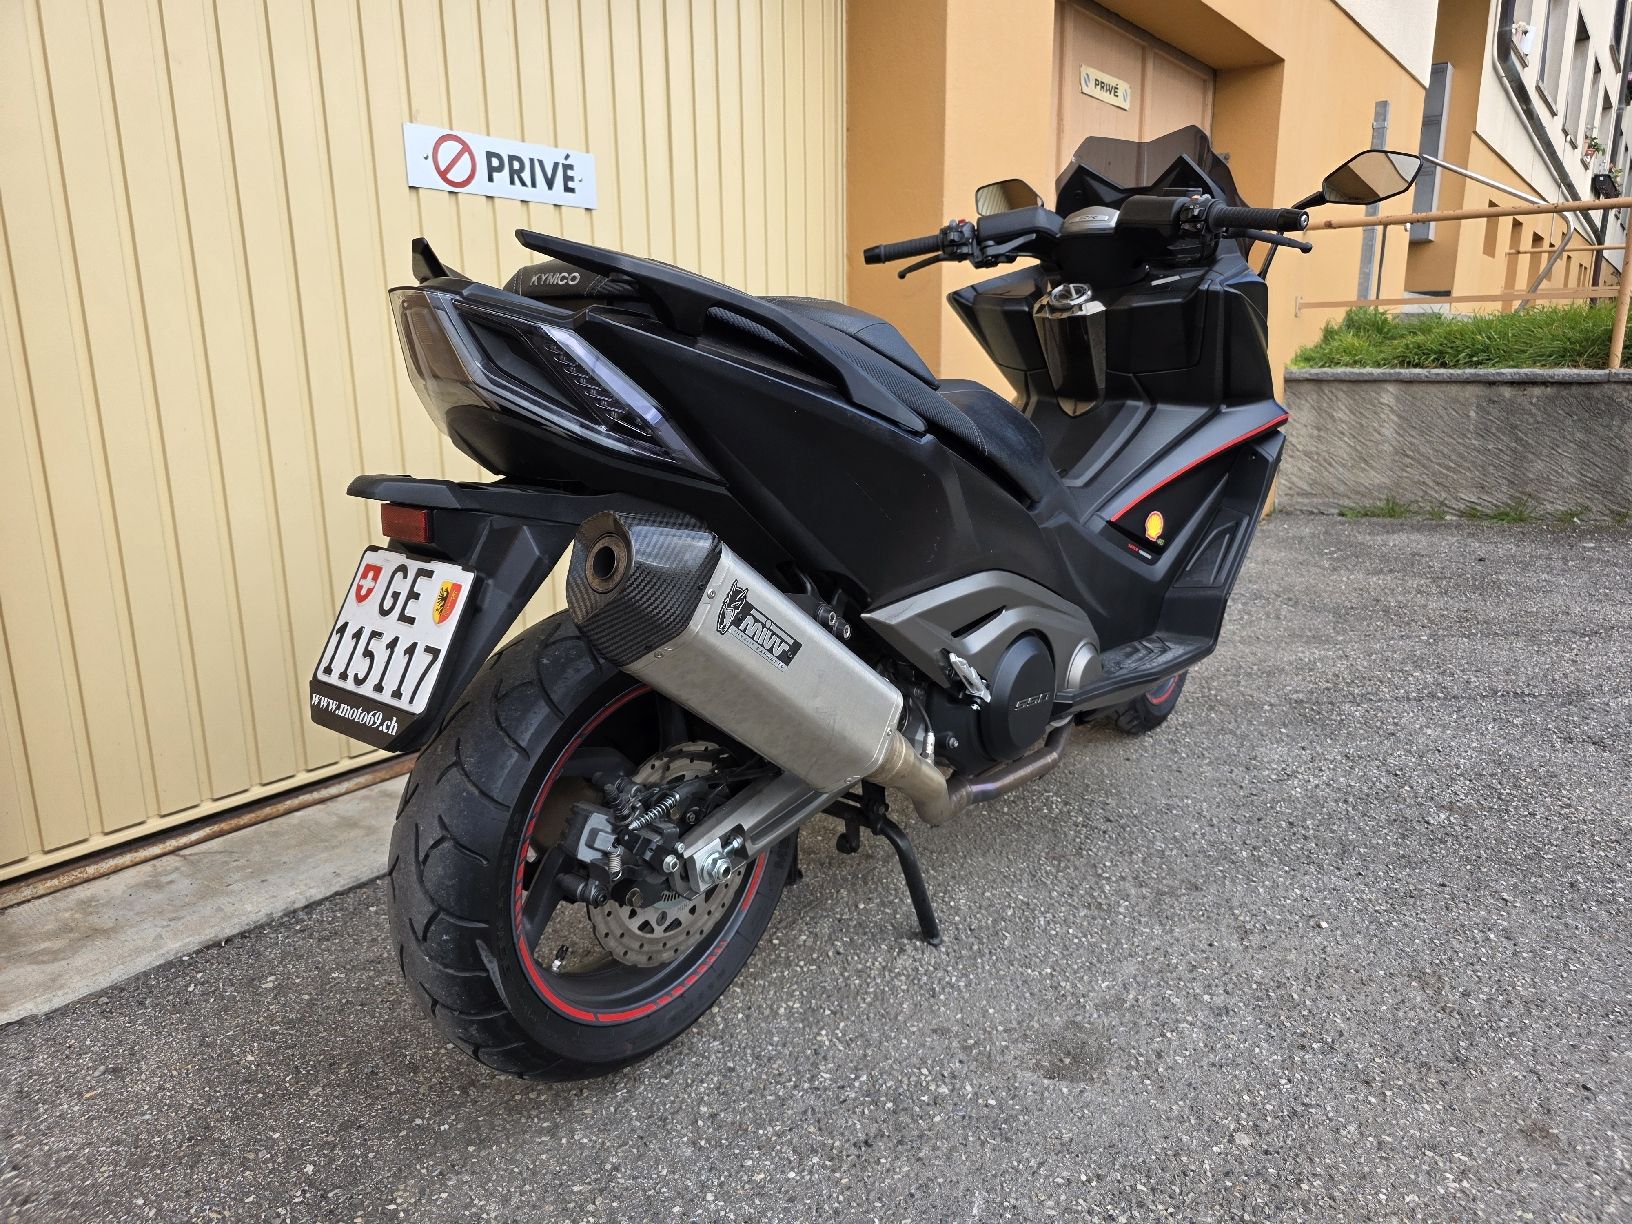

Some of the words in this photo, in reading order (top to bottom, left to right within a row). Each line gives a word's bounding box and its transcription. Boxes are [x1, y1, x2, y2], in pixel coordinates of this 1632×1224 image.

[1094, 78, 1119, 98] PRIVÉ
[485, 150, 576, 194] PRIVÉ
[530, 272, 580, 286] KYMCO
[378, 563, 435, 626] GE
[322, 621, 442, 705] 115117
[311, 693, 398, 736] www.moto69.ch
